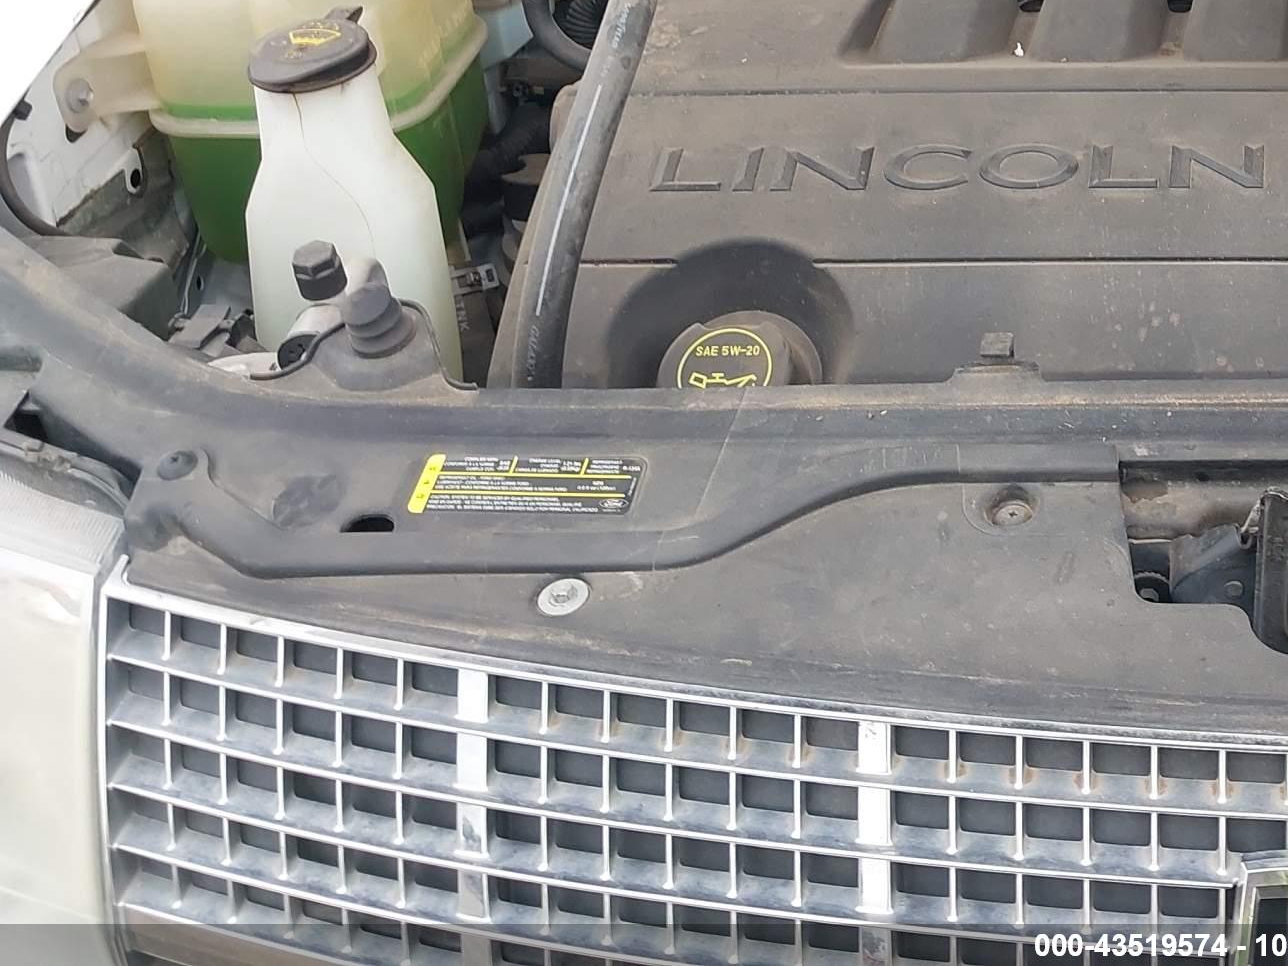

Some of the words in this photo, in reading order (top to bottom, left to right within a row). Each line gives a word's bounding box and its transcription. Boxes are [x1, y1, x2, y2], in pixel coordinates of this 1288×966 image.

[649, 144, 1266, 192] LINCOLN
[695, 345, 719, 357] SAE
[721, 345, 761, 357] 5W-20
